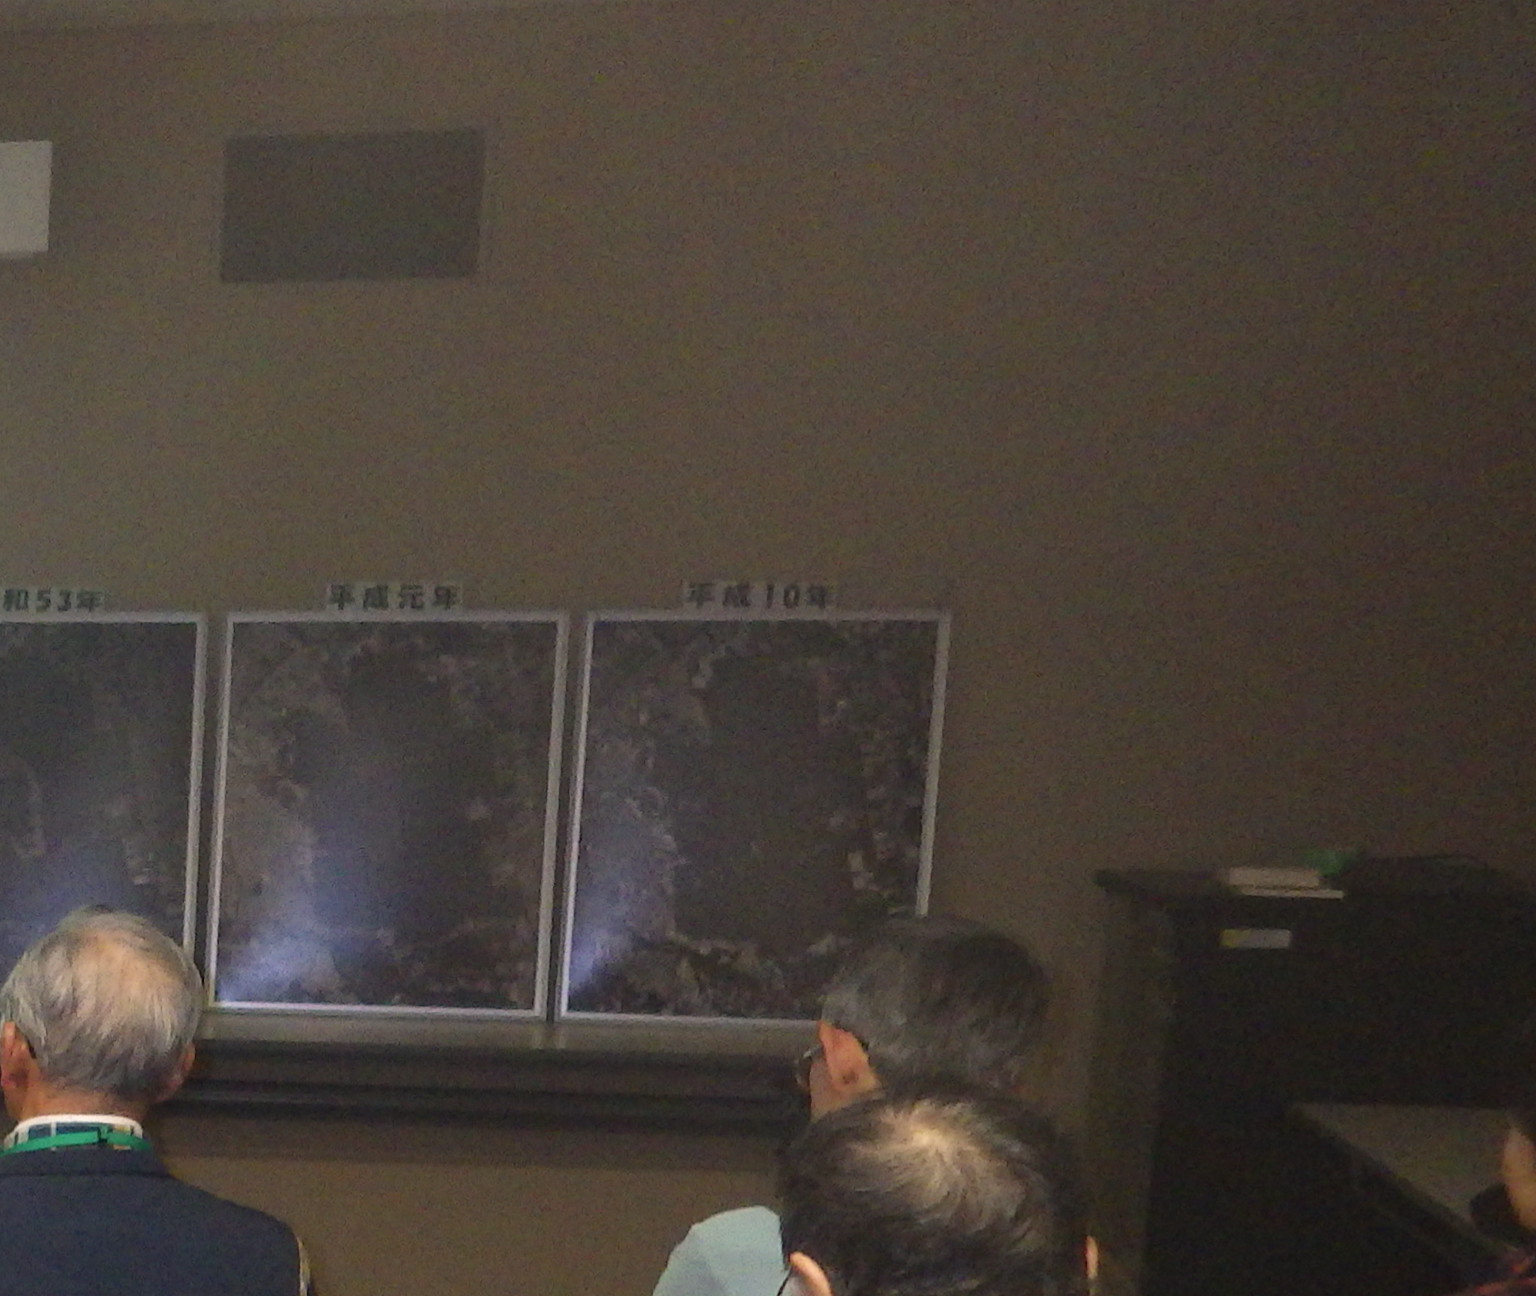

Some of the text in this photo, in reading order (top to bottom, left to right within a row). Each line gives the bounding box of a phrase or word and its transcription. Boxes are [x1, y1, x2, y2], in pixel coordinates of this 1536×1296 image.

[329, 584, 459, 610] 平成元年
[687, 582, 833, 609] 平成10年
